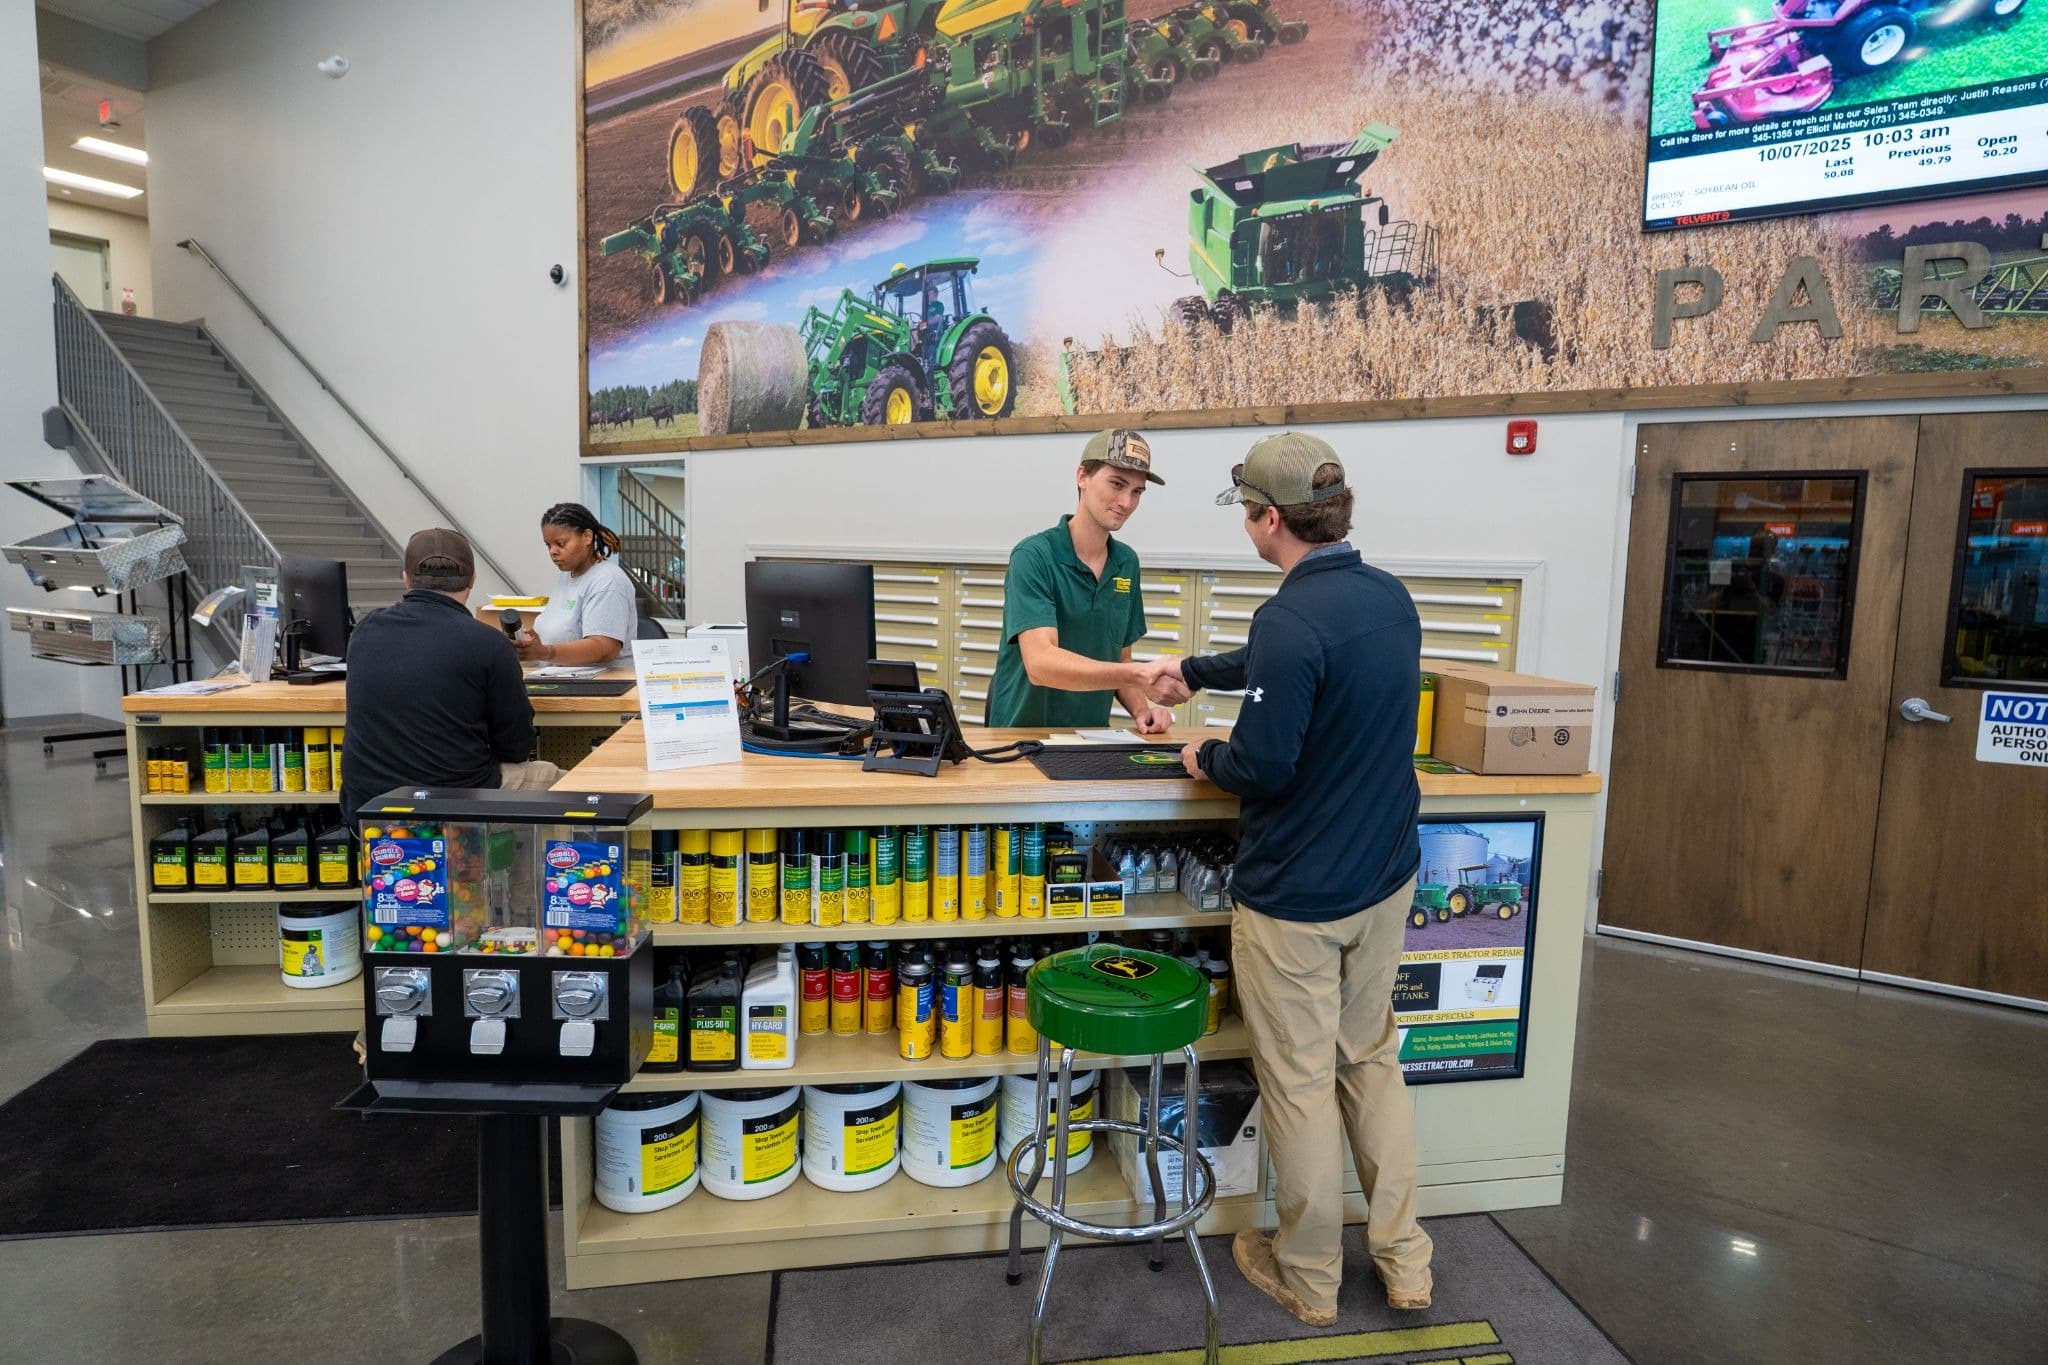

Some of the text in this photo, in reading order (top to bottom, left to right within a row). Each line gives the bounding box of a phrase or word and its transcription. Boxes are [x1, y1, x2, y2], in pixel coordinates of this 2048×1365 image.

[1660, 137, 1675, 147] Call
[1677, 136, 1689, 144] the
[1692, 133, 1713, 142] Store
[1716, 130, 1726, 138] for
[1729, 127, 1750, 136] more
[1752, 122, 1778, 133] details
[1782, 120, 1790, 128] or
[1793, 116, 1816, 126] reach
[1819, 114, 1832, 122] out
[1847, 110, 1861, 118] our
[1864, 106, 1888, 115] Sales
[1892, 102, 1918, 111] Team
[1921, 93, 1957, 106] directly:
[1961, 88, 1989, 100] Justin
[1992, 82, 2036, 95] Reasons
[1753, 106, 1946, 142] 345-1355 or Elliott Marbury (731) 345-0349.
[1758, 126, 1949, 162] 10/07/2025 10:03 am
[1826, 135, 2017, 167] Last Previous Open
[1824, 147, 2017, 178] 50.08 49.79 50.20
[1695, 184, 1737, 194] SOYBEAN
[1741, 180, 1757, 189] OIL
[1676, 212, 1720, 225] TELVENT
[1652, 233, 2048, 349] PAR
[1991, 699, 2048, 720] NOT
[1991, 725, 2048, 738] AUTHO
[1993, 737, 2048, 750] PERSO
[378, 893, 384, 902] 8
[551, 896, 556, 904] 8
[1413, 952, 1449, 960] VINTAGE
[1452, 951, 1490, 959] TRACTOR
[1091, 977, 1154, 1001] DEERE
[1402, 992, 1429, 1000] TANKS
[1436, 1012, 1474, 1020] SPECIALS
[697, 1020, 724, 1029] PLUS-50
[751, 1021, 782, 1030] HY-GARD
[1400, 1059, 1473, 1072] NESSEETRACTOR.COM
[755, 1124, 768, 1132] 200
[654, 1133, 667, 1141] 200
